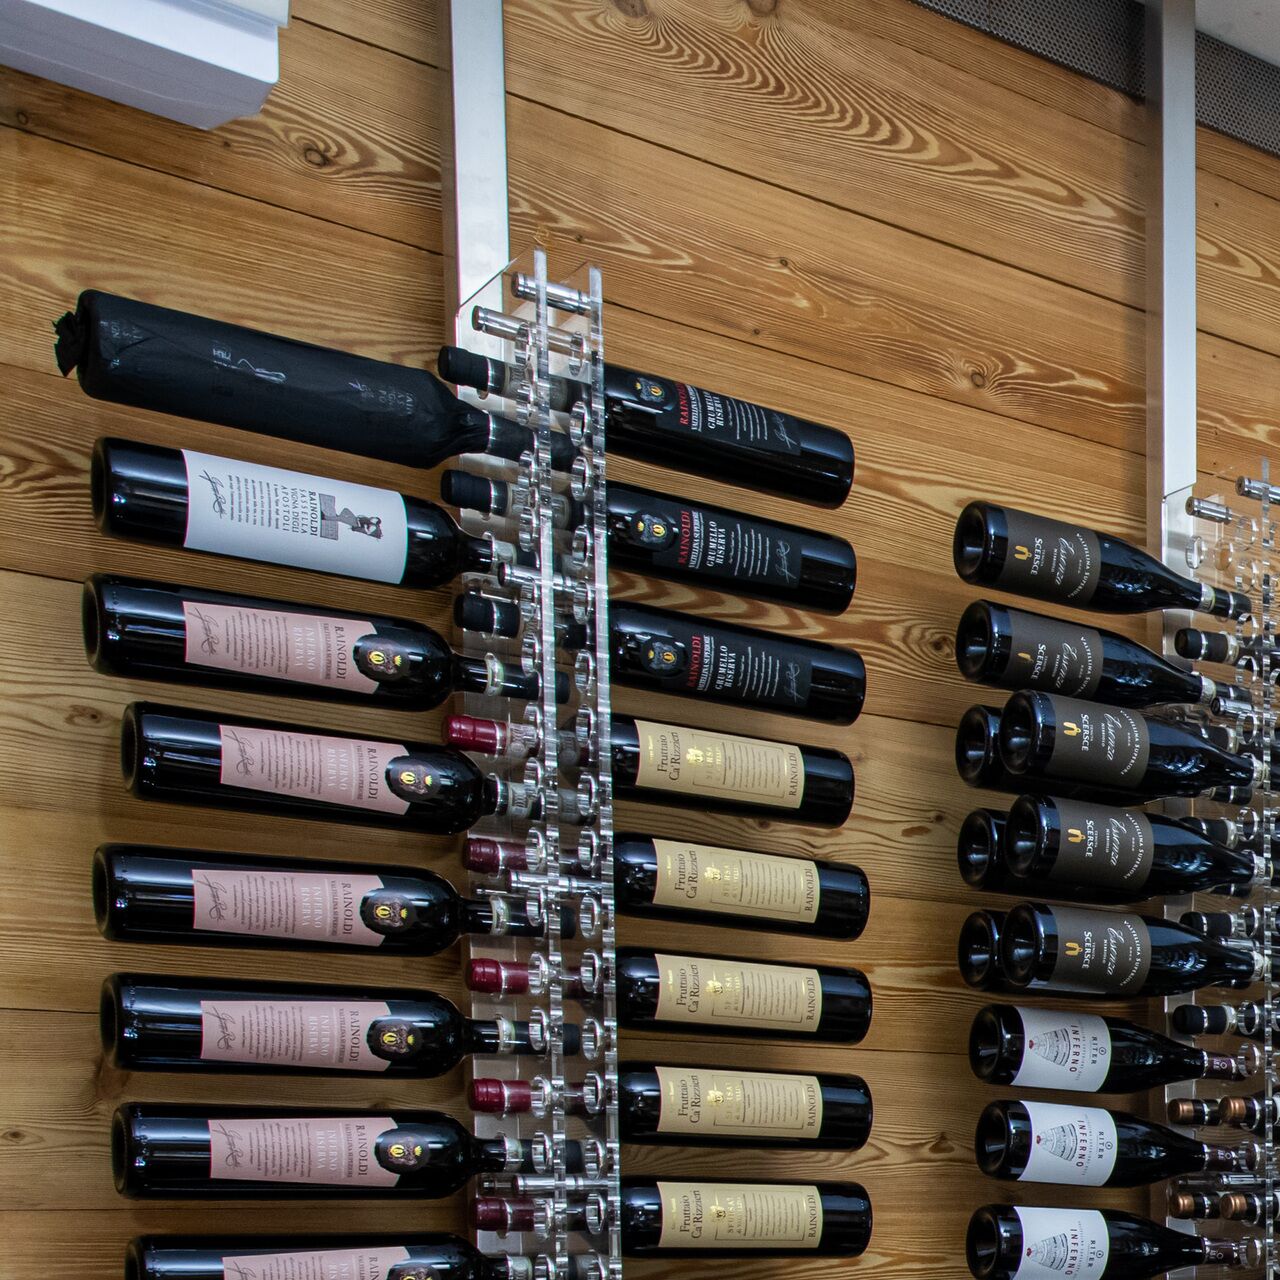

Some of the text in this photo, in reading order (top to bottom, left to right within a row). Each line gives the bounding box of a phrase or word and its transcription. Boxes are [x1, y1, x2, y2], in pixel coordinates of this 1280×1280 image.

[281, 485, 290, 532] APOSTOLI
[299, 488, 308, 534] SASSELLA
[309, 490, 318, 537] RAINOLDI
[706, 520, 717, 567] GRUMELLO
[715, 527, 726, 565] RISERVA
[1029, 536, 1043, 576] SCERSCE
[333, 625, 346, 680] RAINOLDI
[715, 645, 728, 690] GRUMELLO
[724, 651, 736, 688] RISERVA
[656, 734, 668, 773] Fruttaio
[1080, 713, 1090, 752] SCERSCE
[367, 747, 378, 800] RAINOLDI
[789, 751, 798, 797] RAINOLDI
[1085, 818, 1095, 858] SCERSCE
[674, 852, 685, 892] Fruttaio
[804, 868, 814, 912] RAINOLDI
[342, 883, 352, 935] RAINOLDI
[1082, 930, 1093, 970] SCERSCE
[676, 967, 686, 1007] Fruttaio
[806, 977, 815, 1021] RAINOLDI
[350, 1010, 361, 1062] RAINOLDI
[1069, 1024, 1078, 1074] INFERNO
[355, 1124, 368, 1176] RAINOLDI
[1076, 1119, 1084, 1169] INFERNO
[680, 1194, 690, 1233] Fruttaio
[808, 1194, 817, 1238] RAINOLDI
[1065, 1228, 1077, 1277] INFERNO
